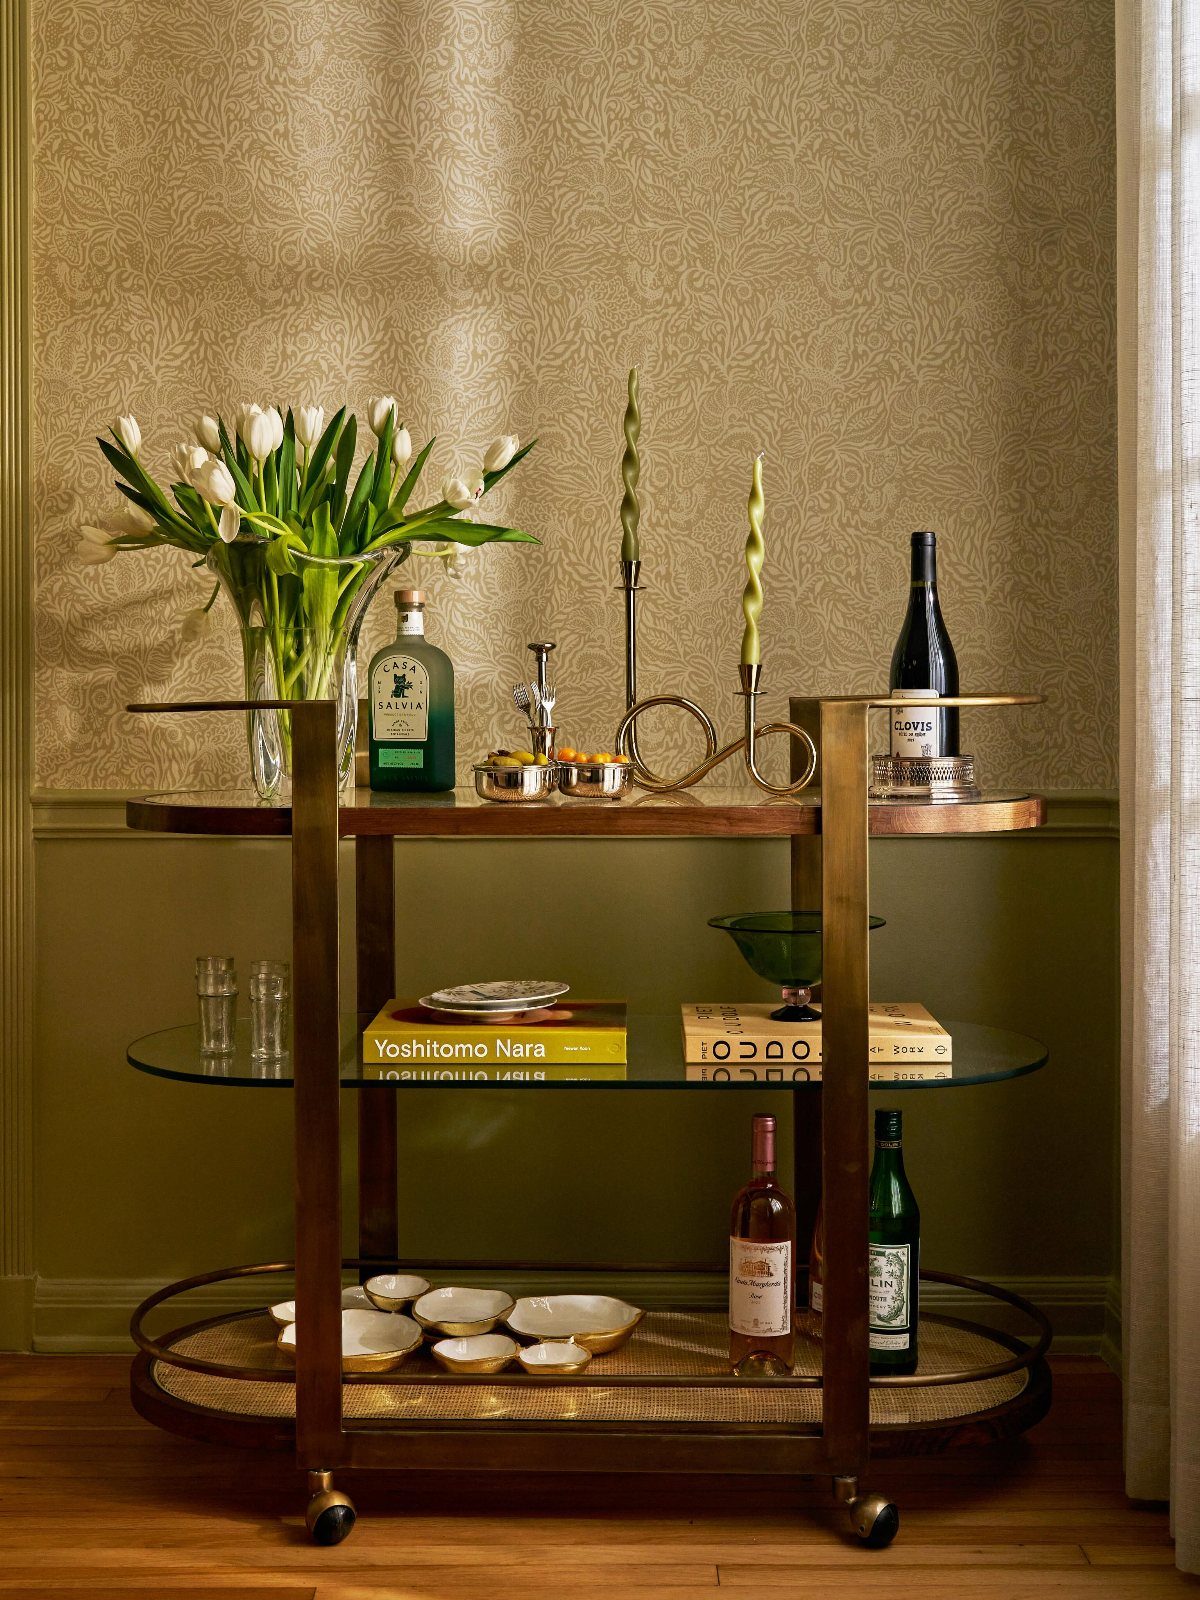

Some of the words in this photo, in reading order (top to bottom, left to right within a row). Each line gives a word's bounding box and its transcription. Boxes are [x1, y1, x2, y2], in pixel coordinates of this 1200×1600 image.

[383, 661, 416, 674] CASA
[378, 701, 423, 710] SALVIA
[894, 720, 933, 732] CLOVIS
[695, 1006, 714, 1020] PIET
[374, 1039, 488, 1058] Yoshitomo
[496, 1039, 546, 1058] Nara
[712, 1040, 822, 1060] OUDO
[869, 1046, 885, 1054] AT
[893, 1044, 925, 1056] WORK
